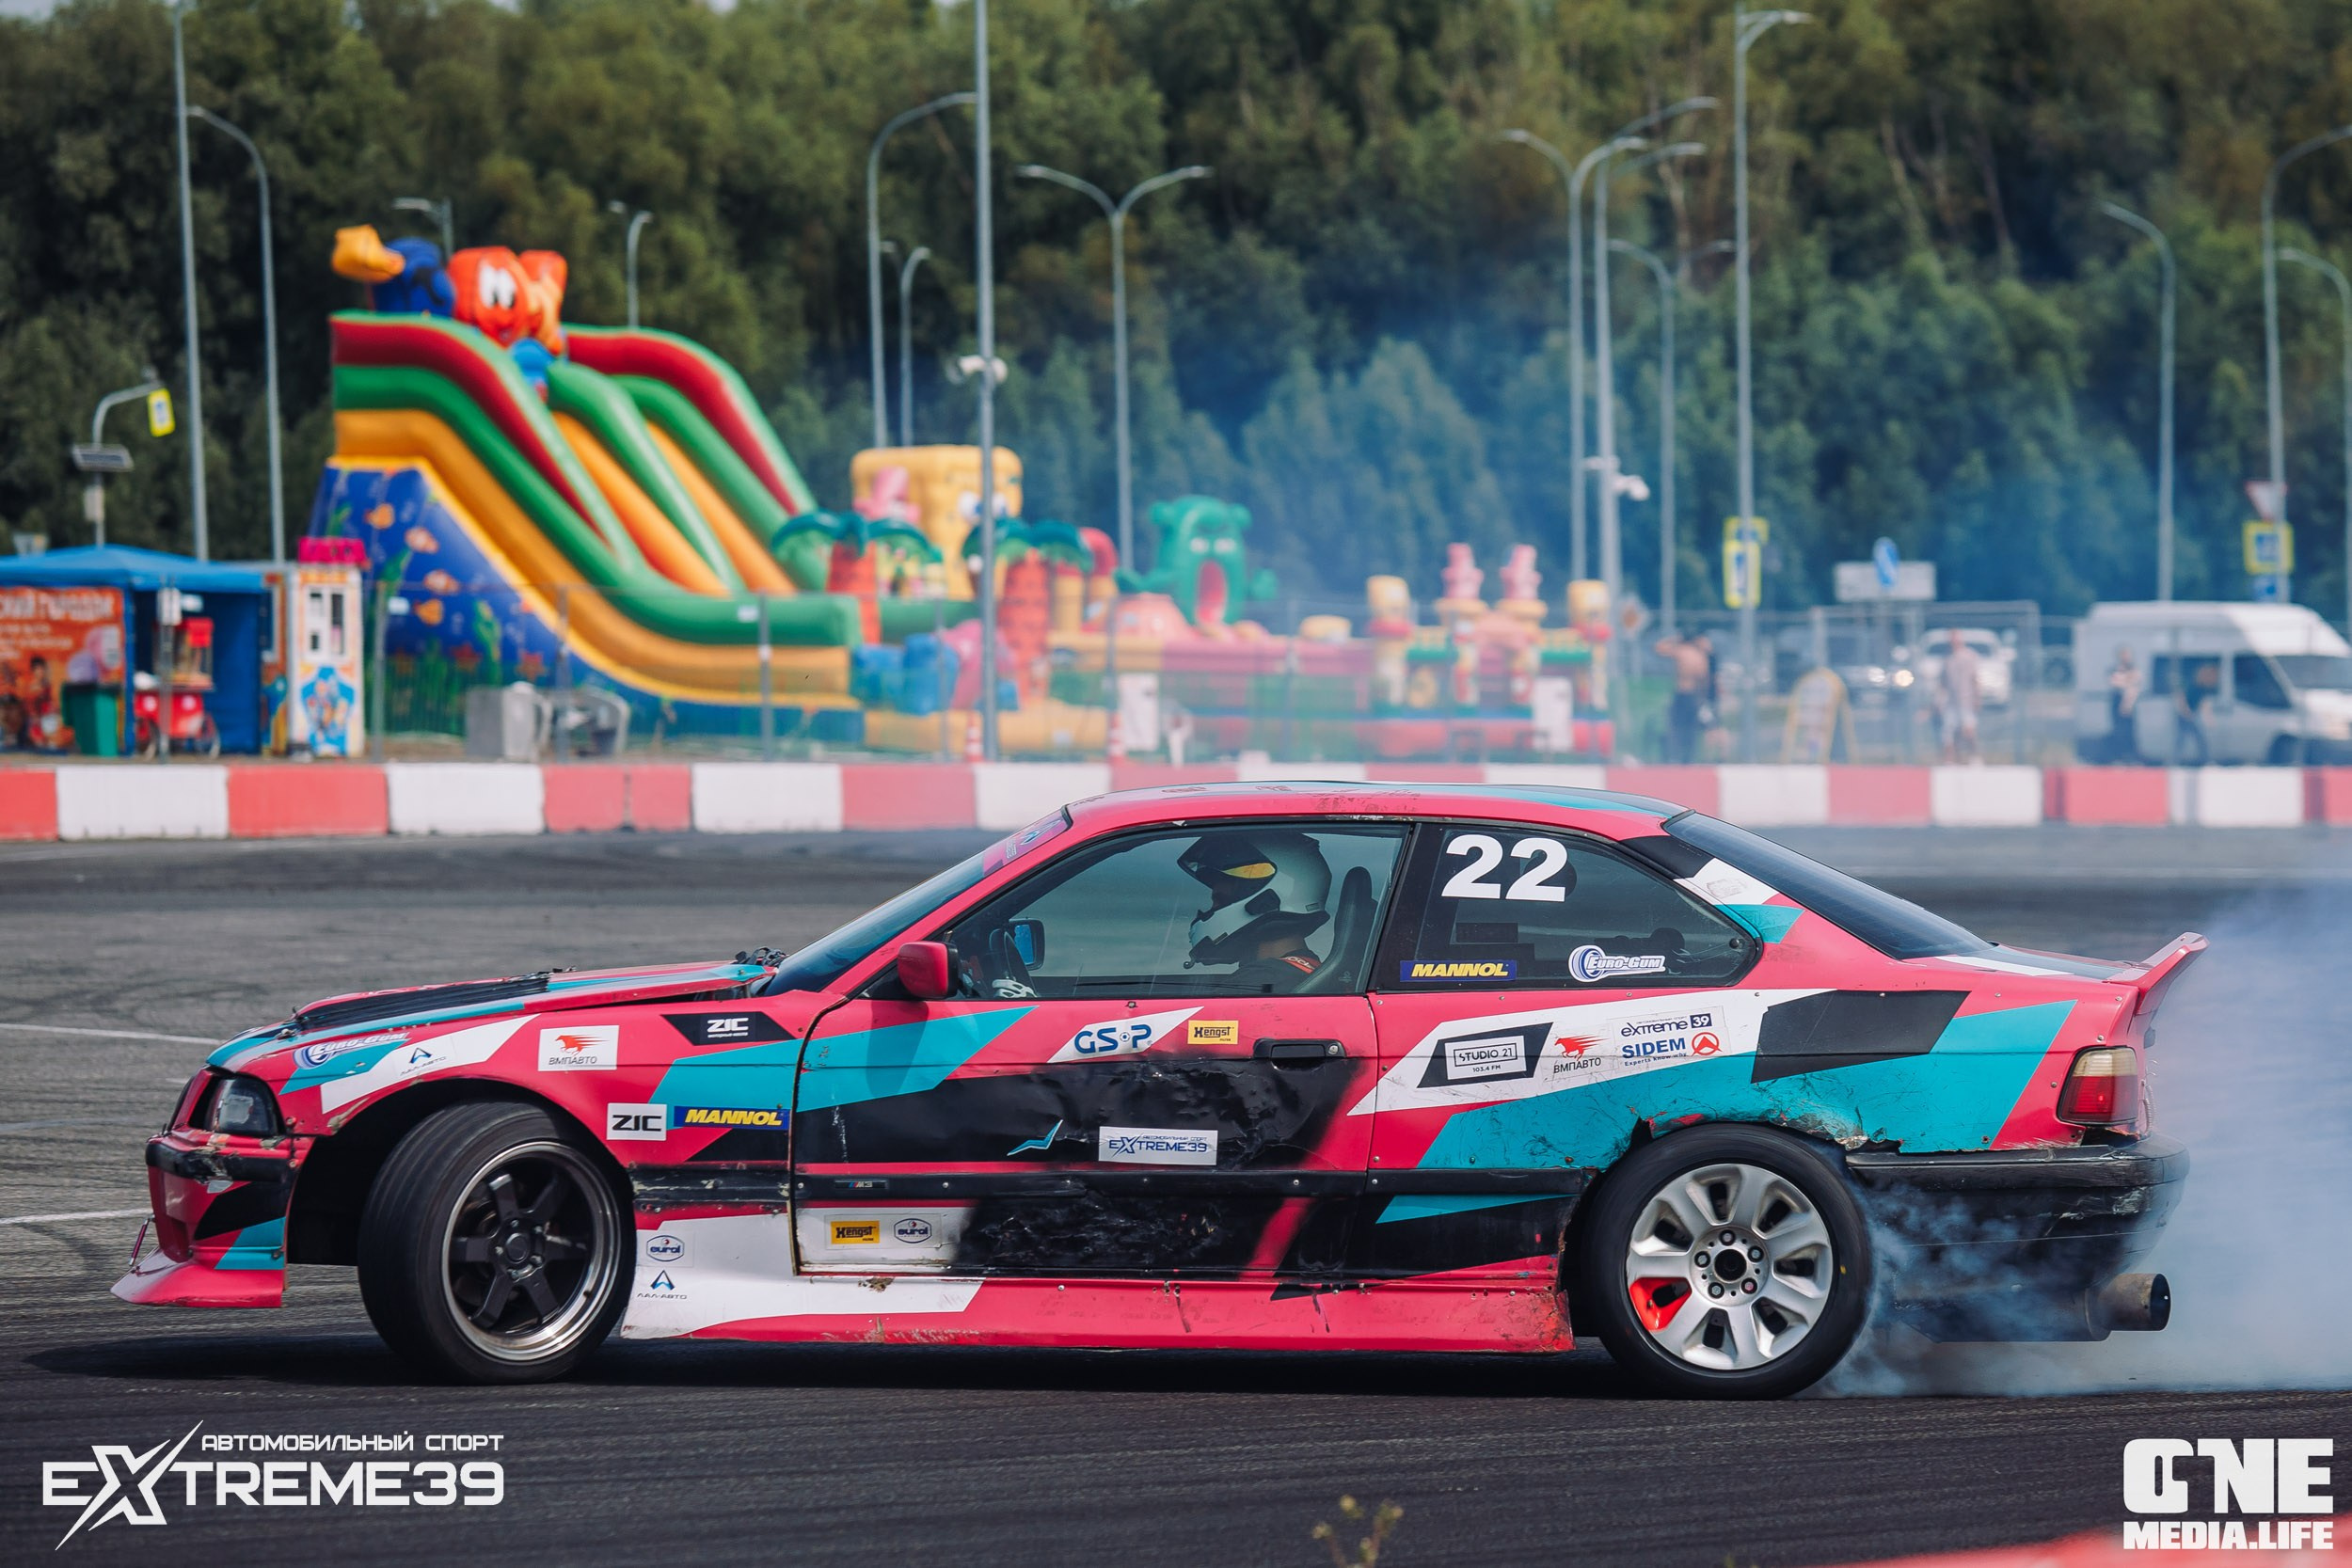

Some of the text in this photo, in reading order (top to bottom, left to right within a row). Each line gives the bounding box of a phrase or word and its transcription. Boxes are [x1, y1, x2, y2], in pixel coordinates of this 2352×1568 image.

[1441, 834, 1568, 902] 22
[1411, 962, 1509, 978] MANNOL
[707, 1017, 749, 1033] ZIC
[1692, 1015, 1710, 1027] 39
[1194, 1026, 1232, 1038] Hengst
[1458, 1047, 1513, 1062] STUDIO 21
[1621, 1037, 1687, 1059] SIDEM
[548, 1054, 598, 1066] ВМПАВТО
[1553, 1056, 1602, 1074] ВМПАВТО
[1624, 1057, 1651, 1067] Experts
[1472, 1065, 1490, 1073] 103.4
[612, 1114, 662, 1132] ZIC
[685, 1108, 783, 1127] MANNOL
[835, 1226, 873, 1239] Hengst
[898, 1227, 929, 1236] eurol
[649, 1244, 681, 1254] eurol
